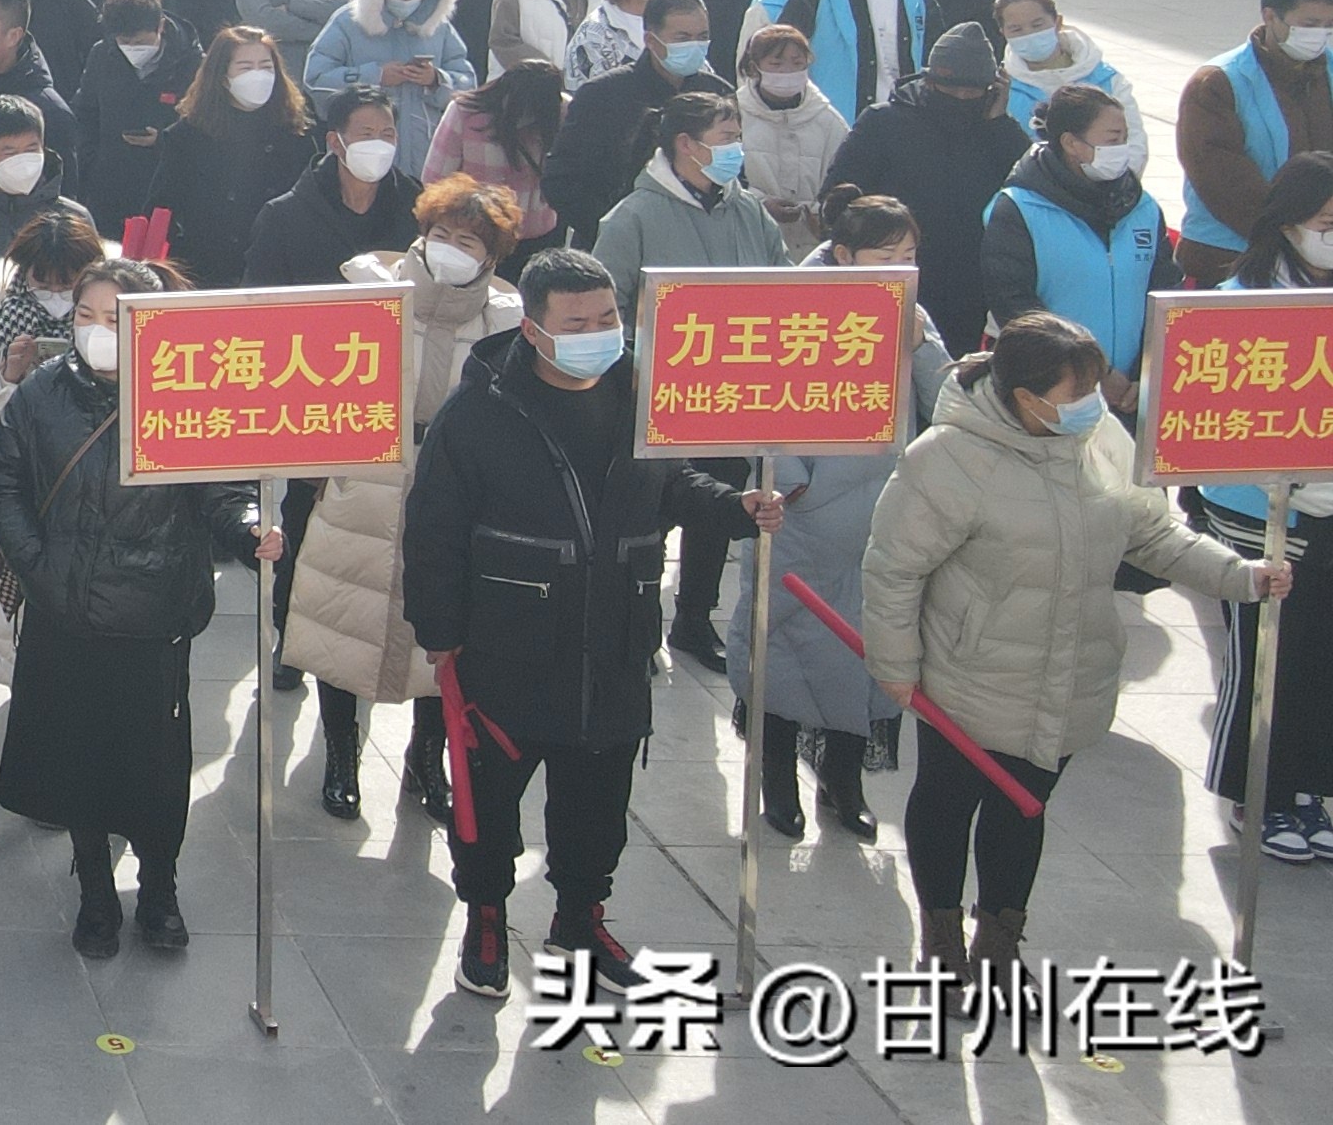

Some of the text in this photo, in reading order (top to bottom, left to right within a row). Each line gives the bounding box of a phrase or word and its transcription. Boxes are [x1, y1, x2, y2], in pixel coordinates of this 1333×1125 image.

[151, 332, 381, 392] 红海人力
[668, 312, 885, 367] 力王劳务
[1173, 336, 1333, 394] 鸿海人
[141, 401, 396, 440] 外出务工人员代表
[654, 381, 891, 414] 外出务工人员代表
[107, 1037, 125, 1050] 5
